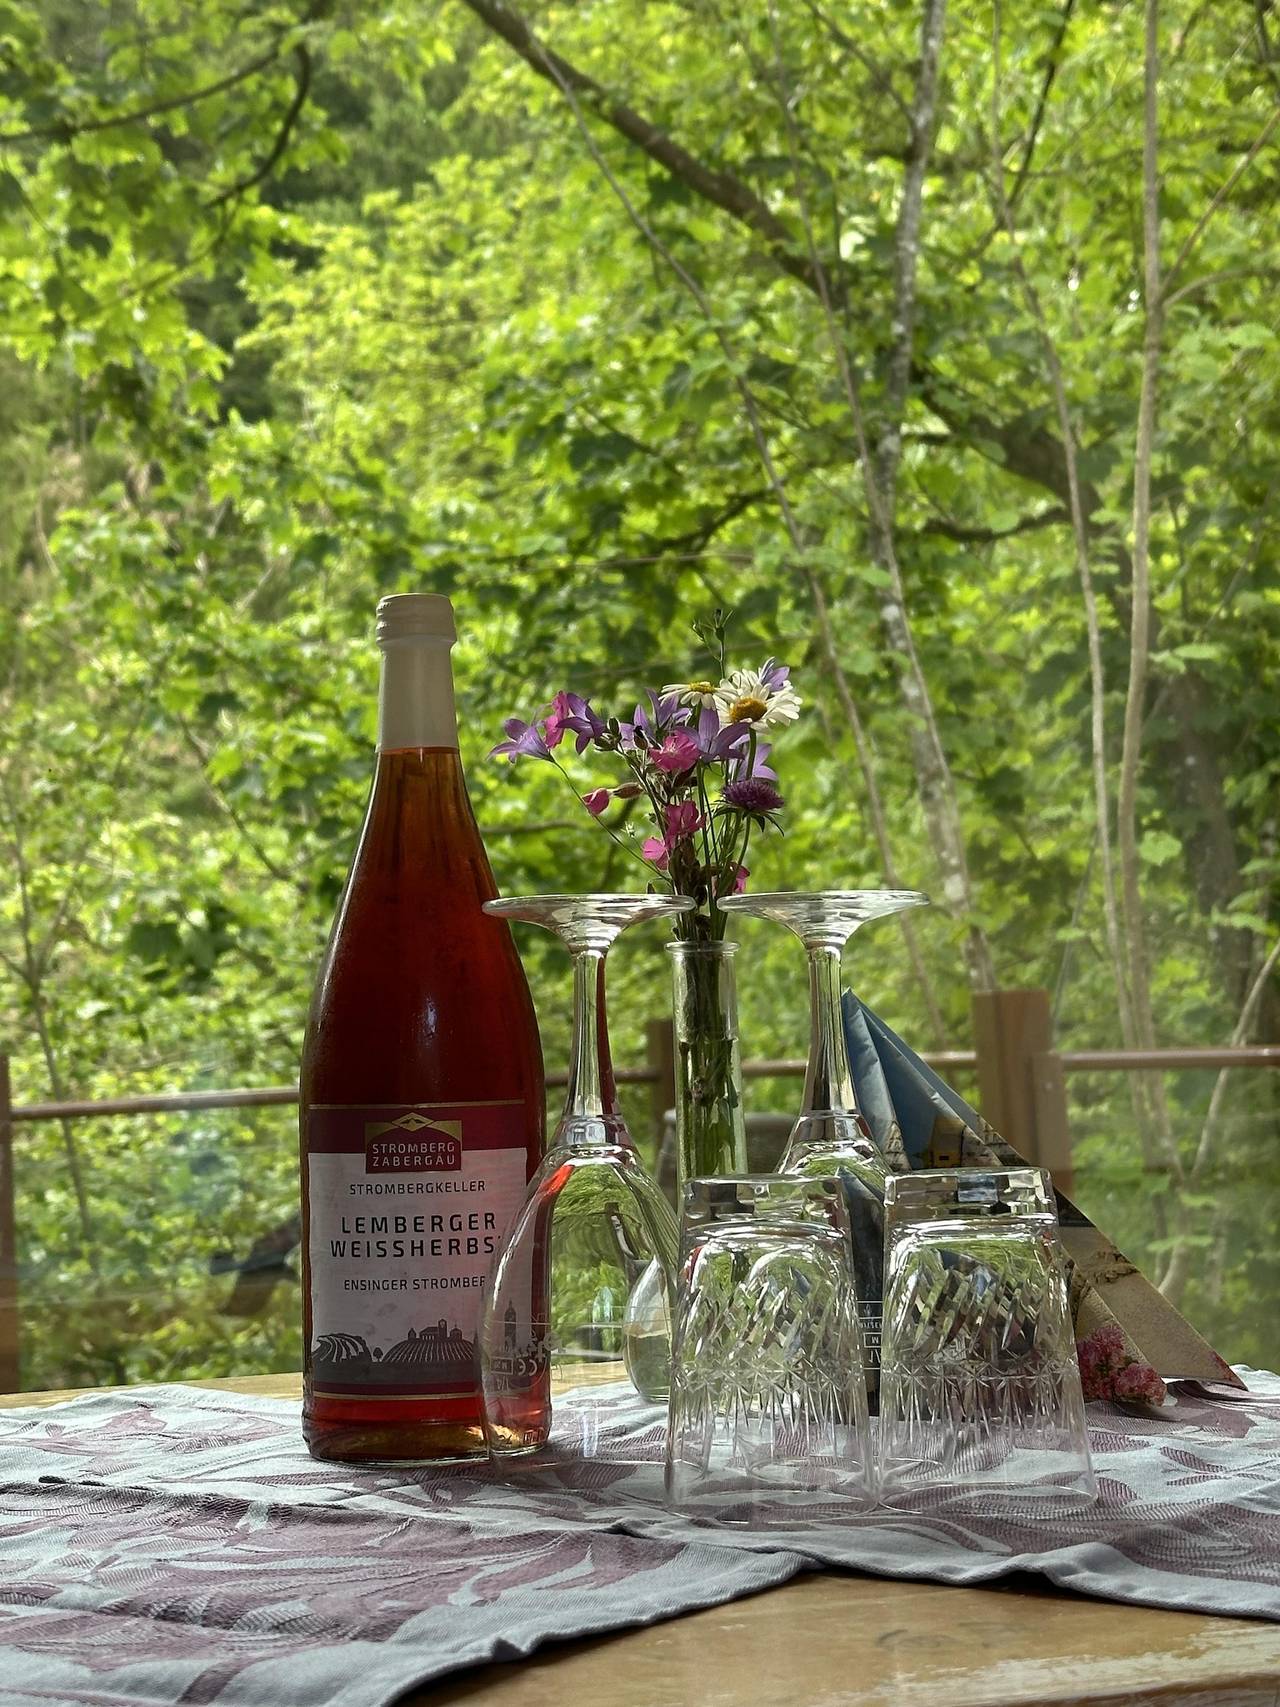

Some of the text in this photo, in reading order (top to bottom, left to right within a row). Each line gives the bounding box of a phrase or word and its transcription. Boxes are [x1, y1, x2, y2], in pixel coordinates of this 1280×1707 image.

[372, 1142, 455, 1154] STROMBERG
[372, 1155, 455, 1167] ZABERGAU
[350, 1180, 486, 1195] STROMBERGKELLER
[341, 1212, 496, 1234] LEMBERGER
[330, 1235, 502, 1258] WEISSHERBS
[343, 1275, 486, 1291] ENSINGER STROMBER
